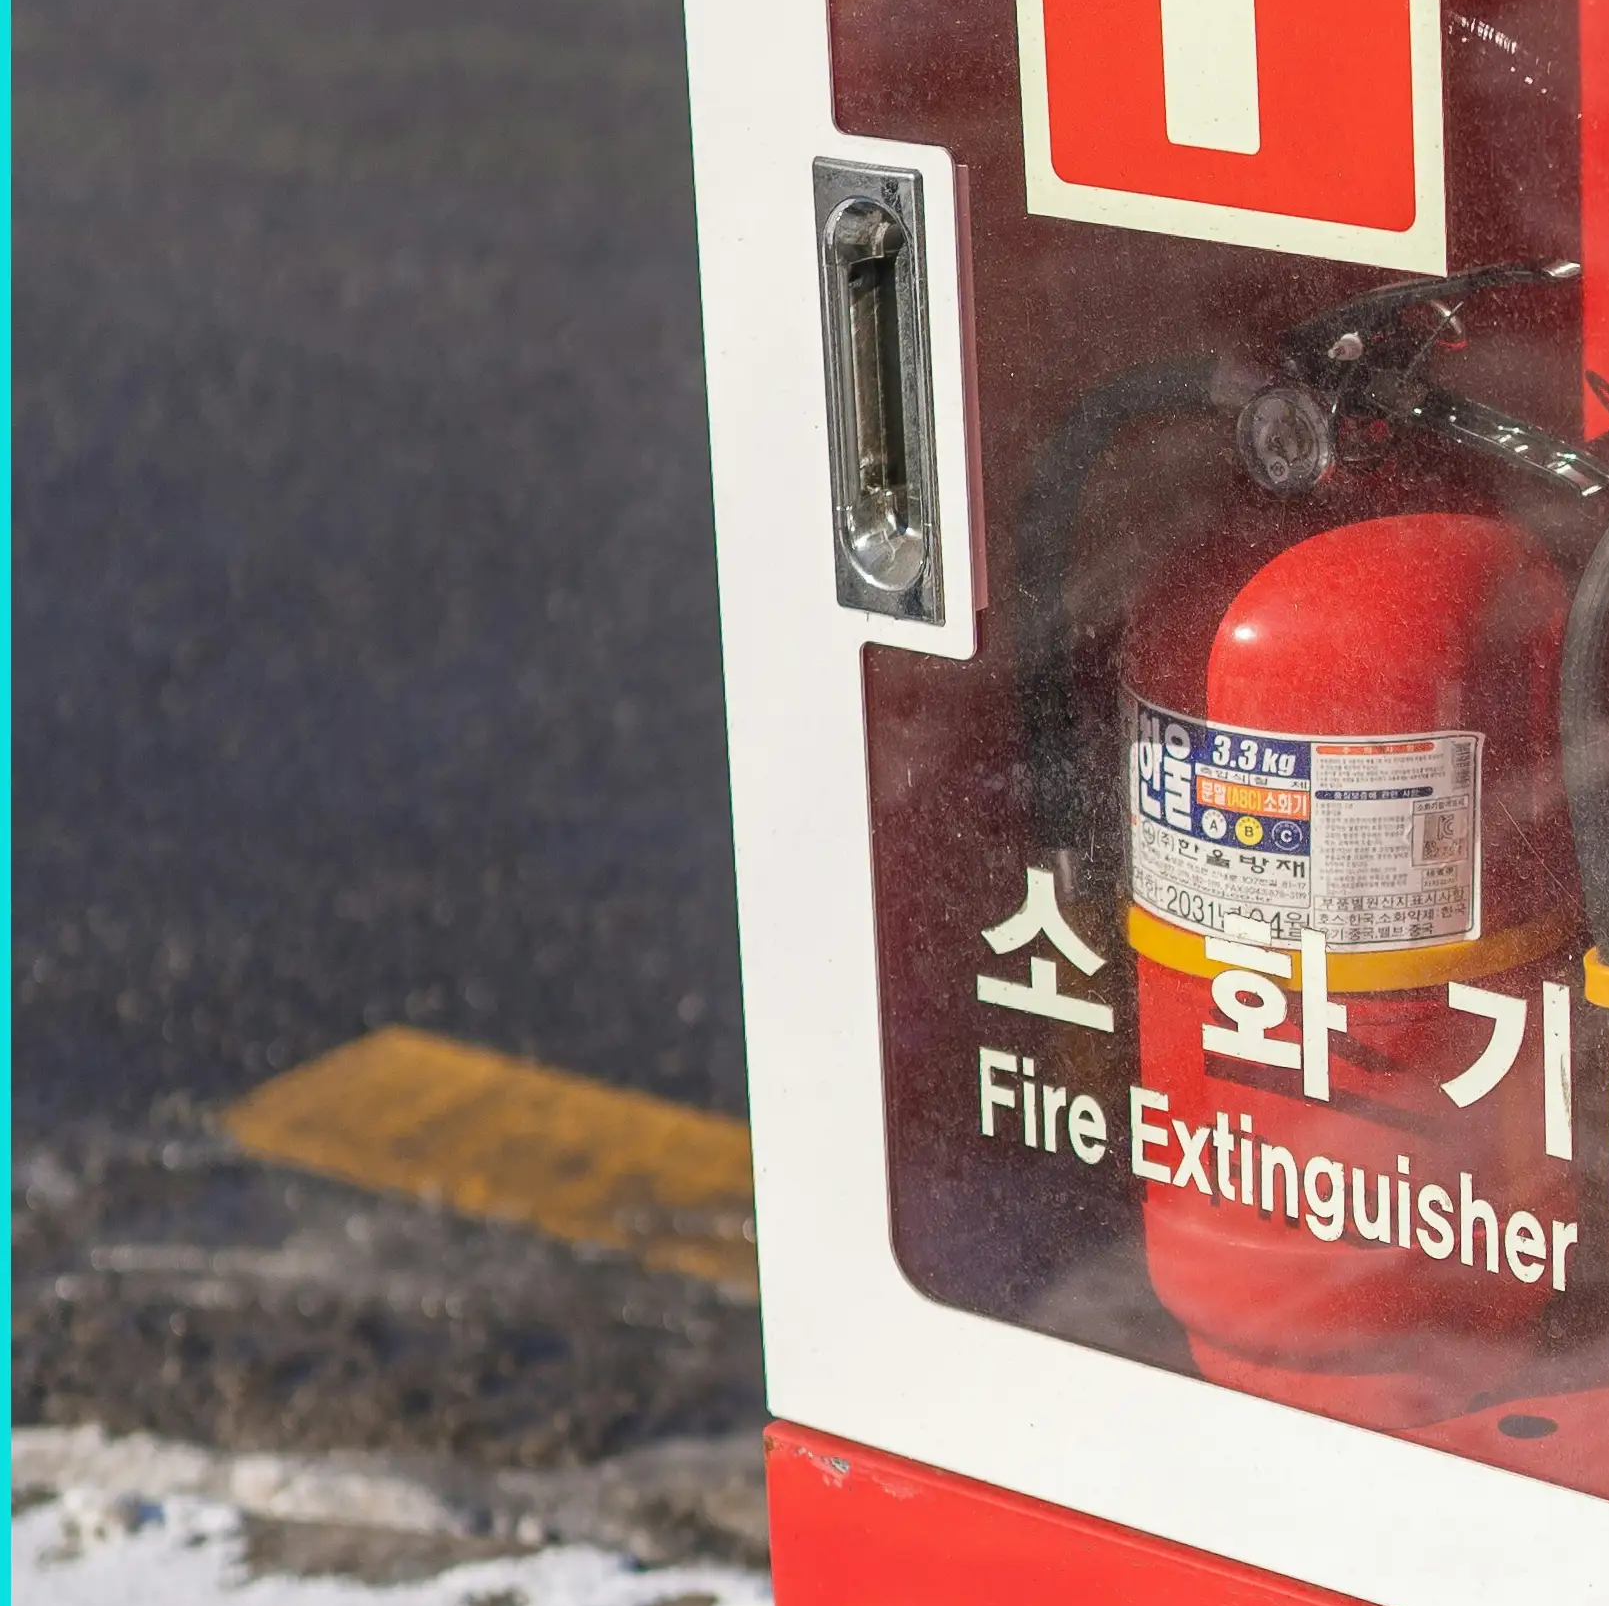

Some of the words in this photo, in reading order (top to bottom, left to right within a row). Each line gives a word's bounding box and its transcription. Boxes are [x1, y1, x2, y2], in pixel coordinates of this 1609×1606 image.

[1212, 735, 1258, 771] 3.3
[1262, 748, 1296, 776] kg
[1209, 820, 1218, 831] A
[1244, 826, 1254, 837] B
[1280, 830, 1292, 843] C
[978, 1047, 1107, 1165] Fire
[1130, 1086, 1579, 1292] Extinguisher
